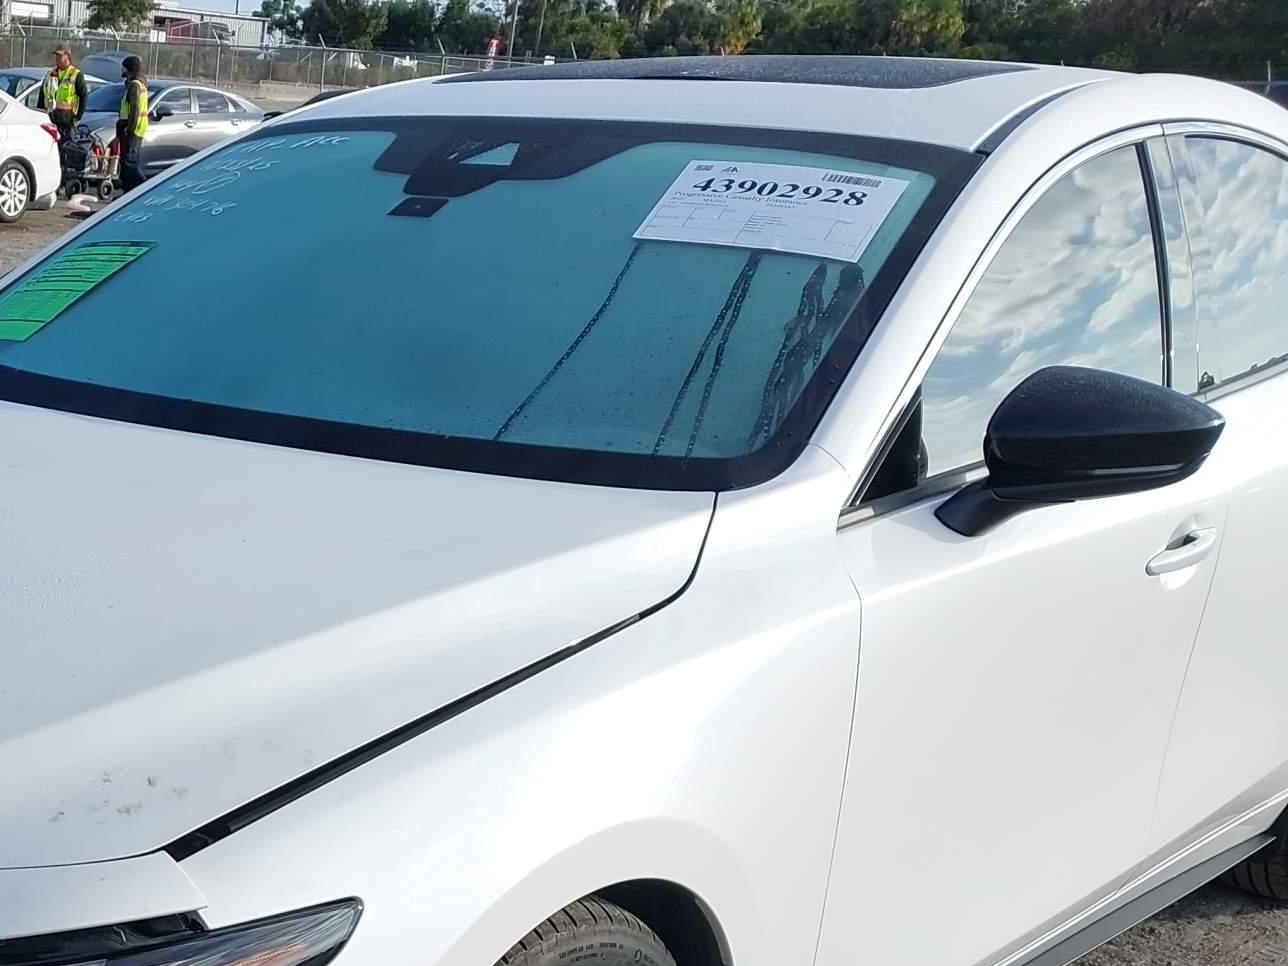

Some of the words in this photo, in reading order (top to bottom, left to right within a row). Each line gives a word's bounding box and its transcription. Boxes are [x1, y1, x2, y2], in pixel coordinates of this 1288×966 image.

[674, 191, 724, 199] Progressive
[725, 194, 762, 202] Casualty
[765, 197, 809, 206] Insurance
[692, 177, 868, 207] 43902928
